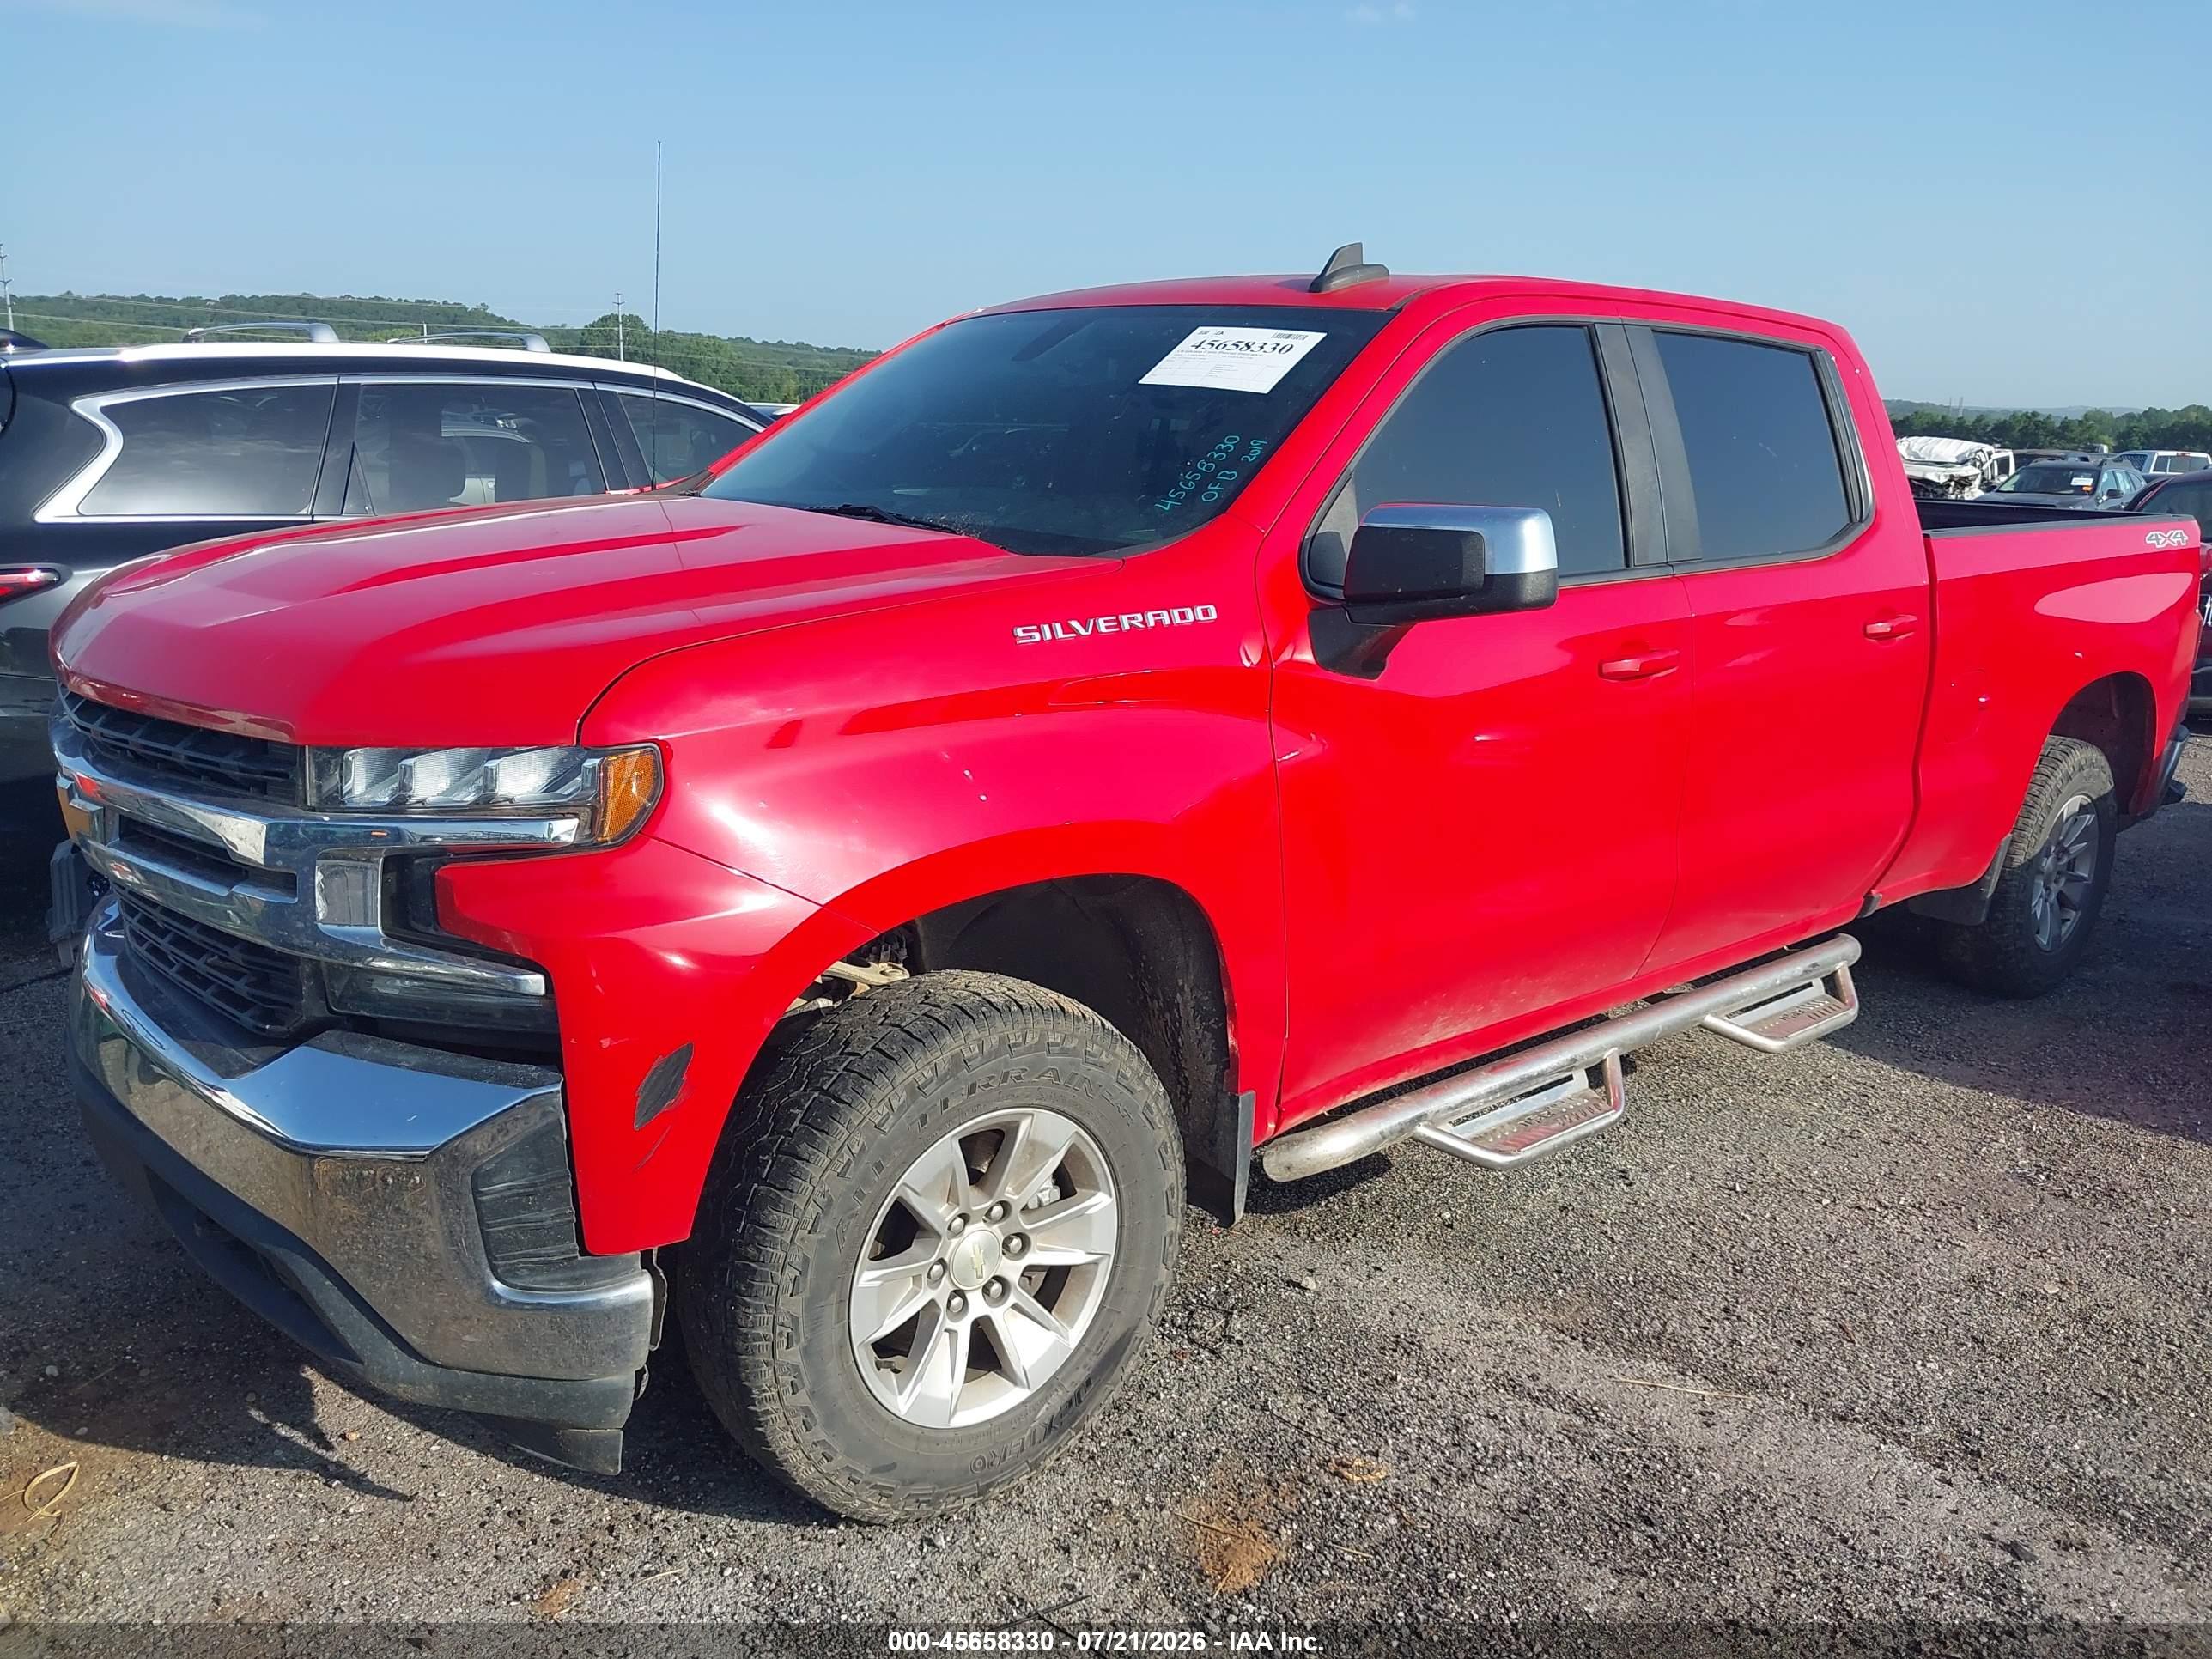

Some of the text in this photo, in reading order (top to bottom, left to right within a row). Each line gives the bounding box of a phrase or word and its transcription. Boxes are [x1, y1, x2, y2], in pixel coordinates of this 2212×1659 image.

[1189, 339, 1295, 355] 45658330
[1154, 434, 1240, 511] 45658330
[1013, 604, 1218, 645] SILVERADO
[906, 1066, 1097, 1135] TERRAIN
